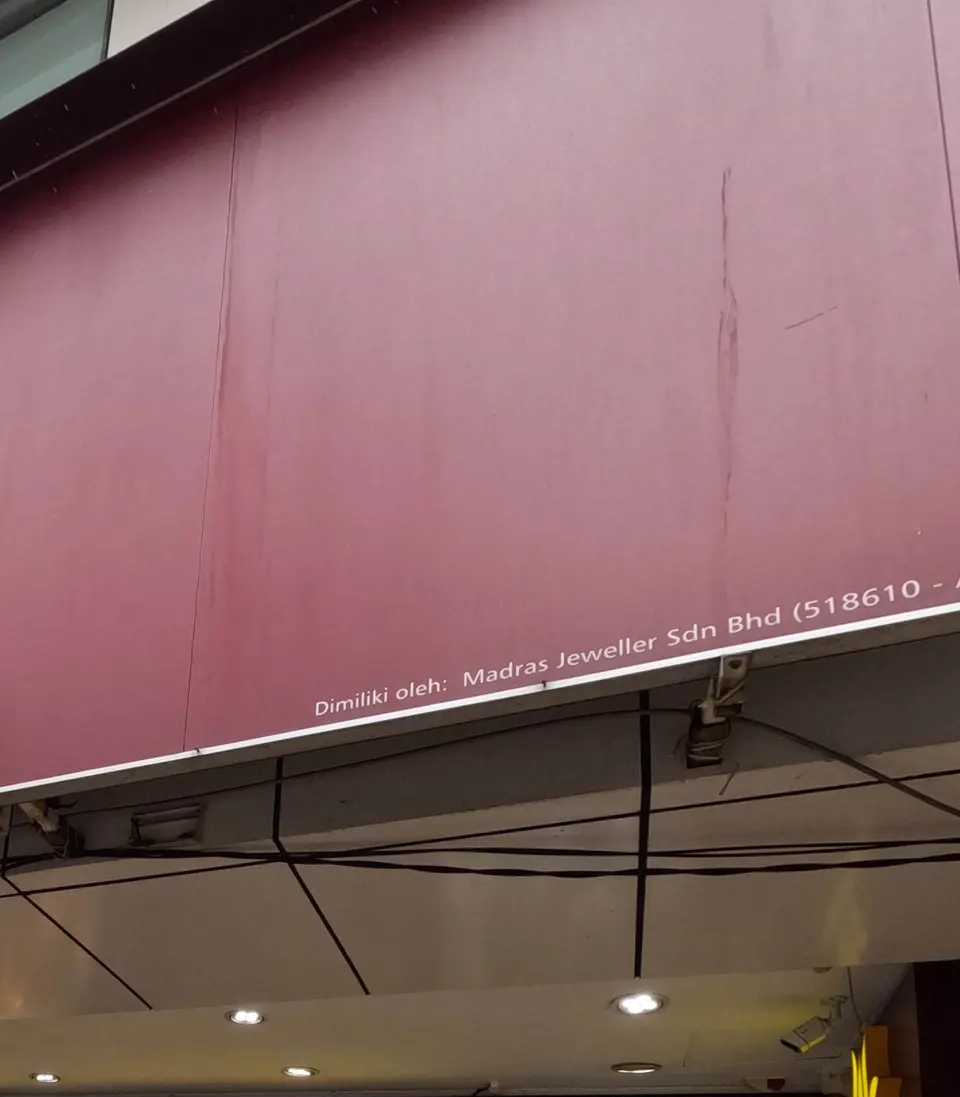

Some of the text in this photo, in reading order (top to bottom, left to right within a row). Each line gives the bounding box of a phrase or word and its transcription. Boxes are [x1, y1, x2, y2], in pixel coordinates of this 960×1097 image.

[315, 687, 388, 716] Dimiliki
[395, 678, 448, 700] oleh:
[462, 654, 549, 688] Madras
[556, 634, 658, 670] Jeweller
[667, 622, 718, 647] Sdn
[728, 607, 782, 634] Bhd
[793, 578, 921, 625] (518610
